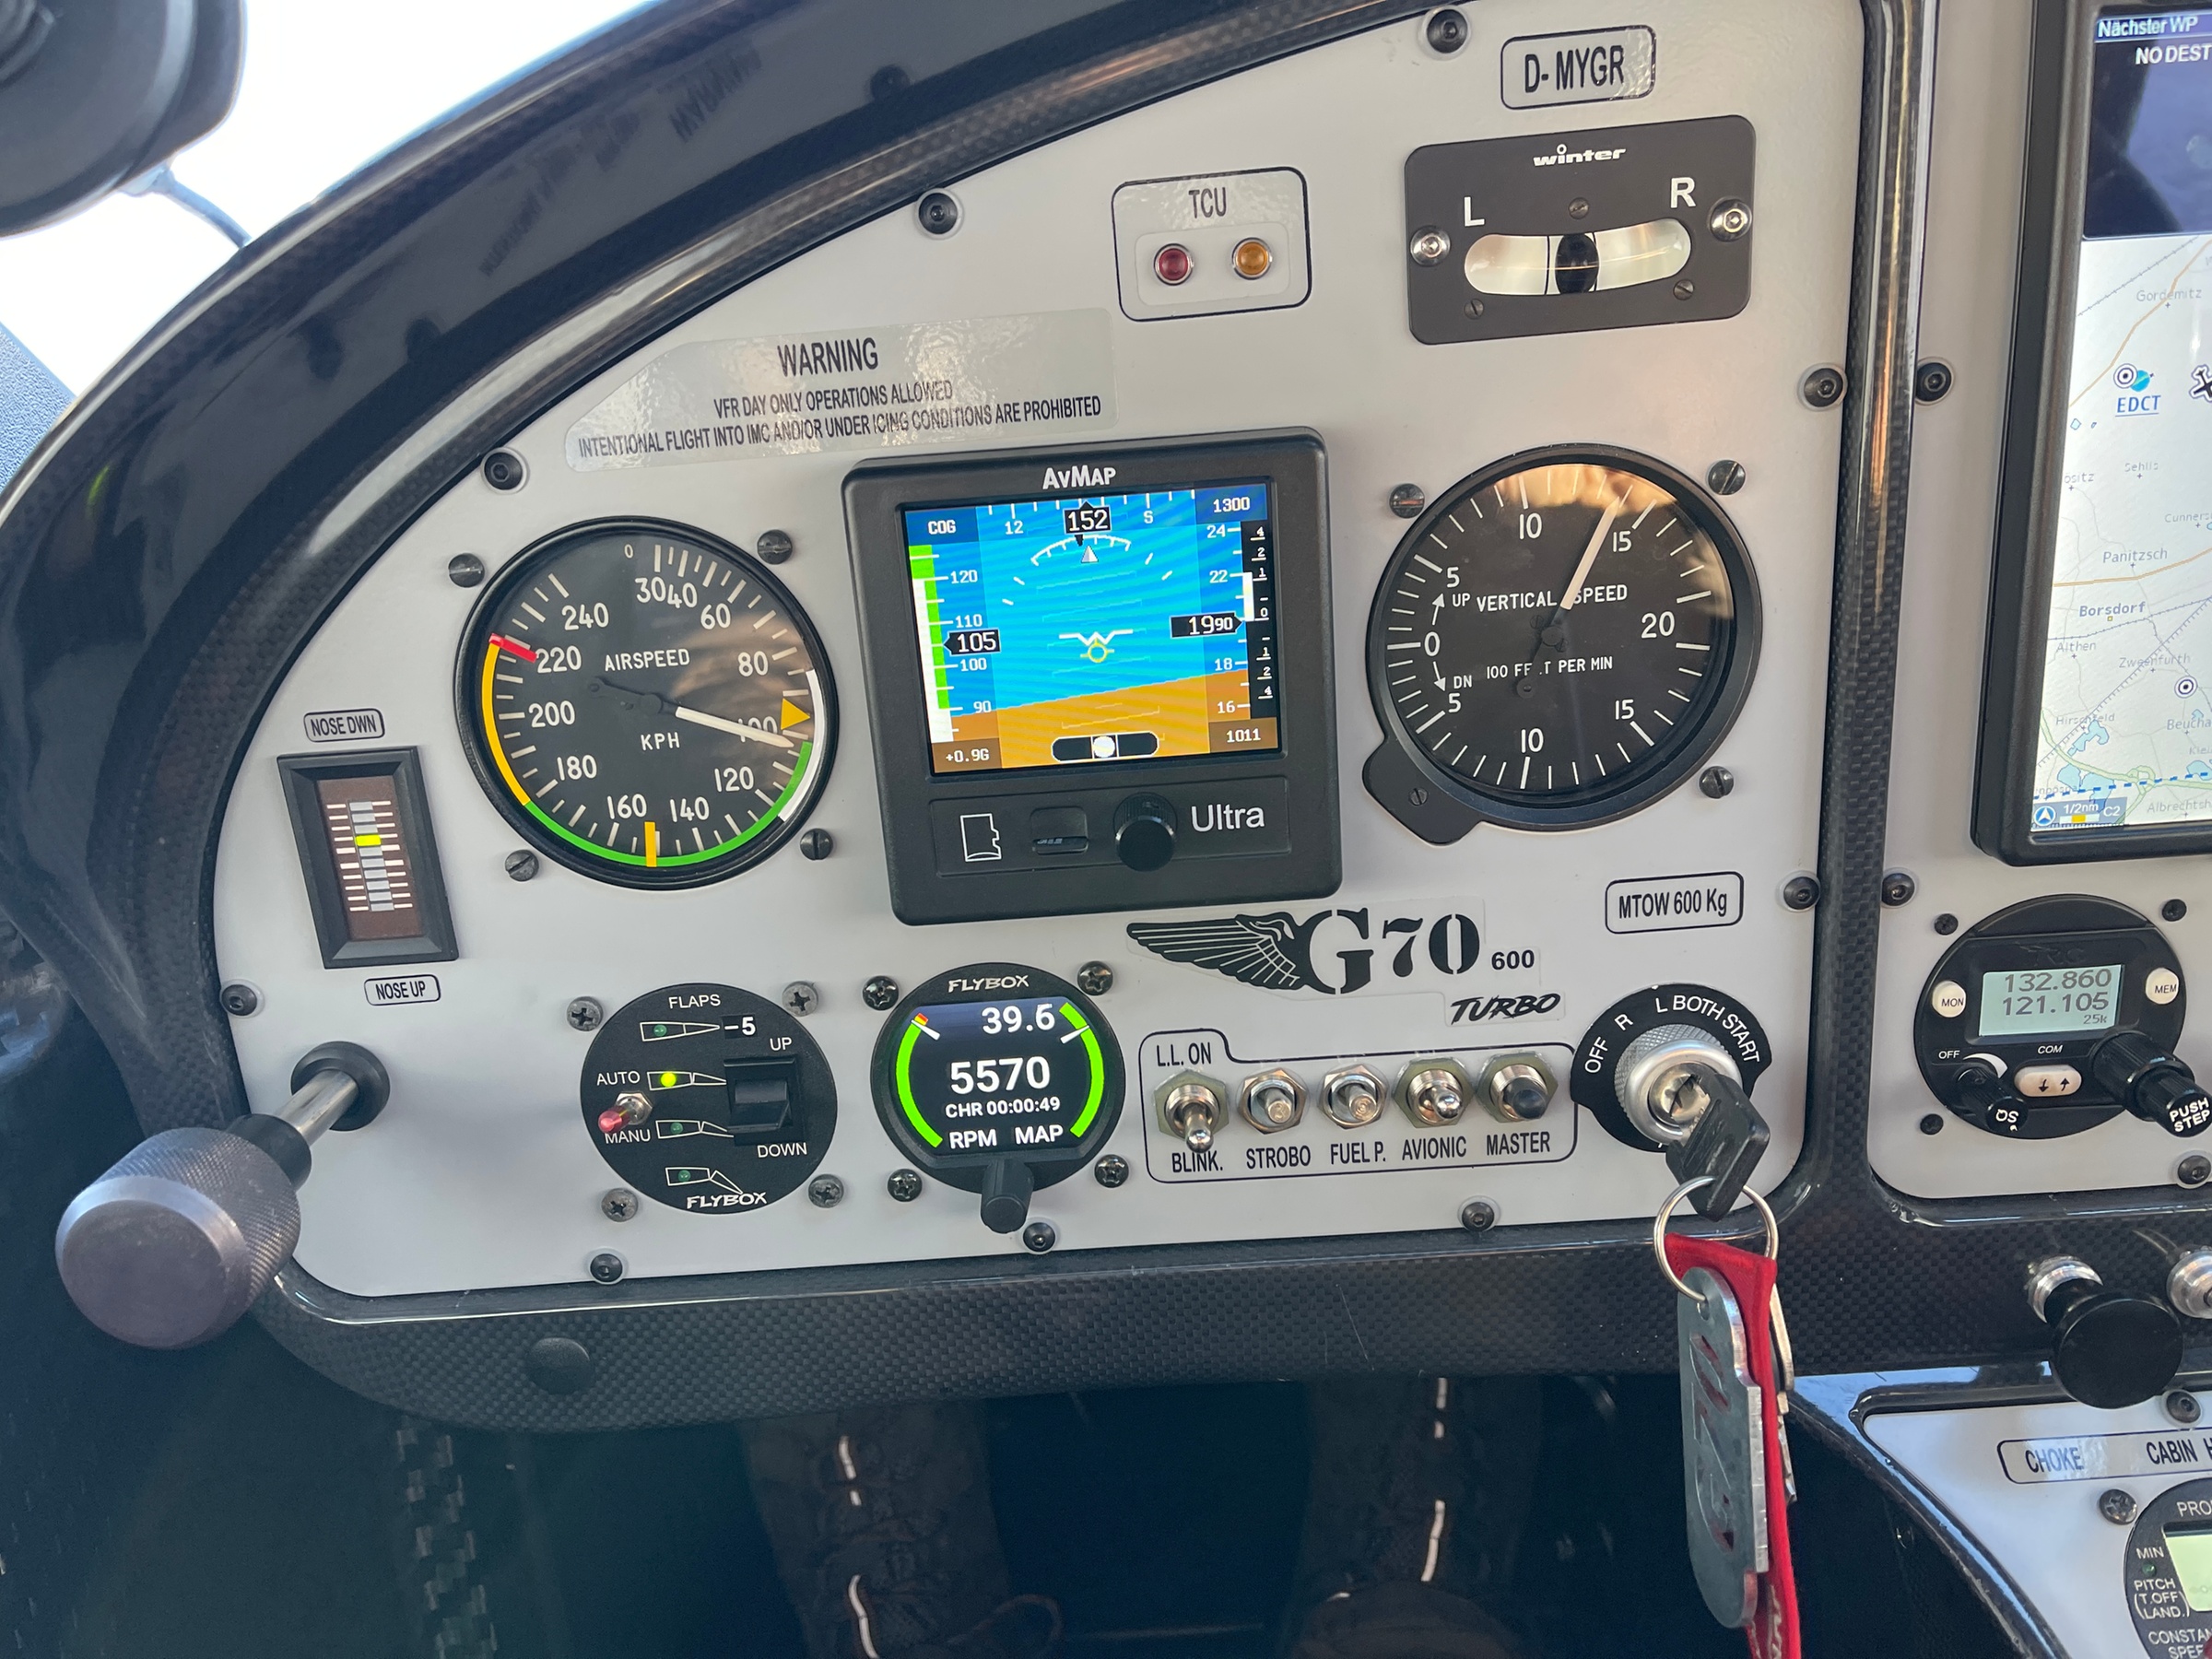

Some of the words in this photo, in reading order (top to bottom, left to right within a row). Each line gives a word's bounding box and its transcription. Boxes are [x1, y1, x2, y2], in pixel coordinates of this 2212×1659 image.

[2098, 18, 2168, 38] Nächster
[2170, 16, 2198, 32] WP
[2136, 46, 2163, 65] NO
[2165, 43, 2212, 63] DEST
[1556, 45, 1625, 91] MYGR
[1533, 143, 1627, 166] winter
[1188, 186, 1227, 219] TCU
[1669, 177, 1697, 209] R
[1463, 196, 1485, 228] L
[777, 337, 878, 377] WARNING
[713, 397, 741, 419] VFR
[742, 394, 767, 417] DAY
[770, 391, 803, 414] ONLY
[806, 385, 888, 411] OPERATIONS
[890, 380, 953, 404] ALLOWED
[2117, 395, 2161, 413] EDCT
[579, 431, 664, 458] INTENTIONAL
[665, 428, 710, 450] FLIGHT
[713, 425, 745, 447] INTO
[747, 423, 770, 444] IMC
[773, 418, 823, 441] AND/OR
[825, 414, 871, 438] UNDER
[873, 412, 910, 434] ICING
[912, 405, 993, 430] CONDITIONS
[995, 402, 1020, 424] ARE
[1023, 395, 1101, 422] PROHIBITED
[1213, 497, 1251, 513] 1300
[927, 519, 957, 535] COG
[1005, 521, 1024, 535] 12
[1067, 509, 1109, 532] 152
[1206, 524, 1227, 538] 24
[1256, 526, 1265, 536] 4
[1519, 513, 1543, 539] 10
[624, 545, 634, 559] 0
[1257, 547, 1265, 558] 2
[1612, 530, 1632, 553] 15
[2103, 547, 2168, 563] Panitzsch
[950, 569, 978, 583] 120
[1209, 570, 1228, 583] 22
[1259, 567, 1265, 578] 1
[1446, 567, 1460, 588] 5
[635, 576, 666, 603] 30
[667, 582, 698, 608] 40
[1452, 593, 1471, 607] UP
[1477, 590, 1558, 613] VERTICAL
[1571, 584, 1628, 605] SPEED
[562, 602, 610, 631] 240
[700, 605, 732, 629] 60
[1260, 607, 1268, 618] 0
[2079, 601, 2146, 618] Borsdorf
[955, 614, 982, 628] 110
[1188, 615, 1233, 636] 1990
[1641, 611, 1676, 639] 20
[957, 631, 996, 653] 105
[1263, 647, 1269, 657] 1
[1424, 631, 1441, 656] 0
[2056, 641, 2096, 653] Althen
[535, 645, 582, 675] 220
[605, 648, 690, 672] AIRSPEED
[737, 652, 769, 677] 80
[959, 657, 987, 671] 100
[1214, 658, 1233, 672] 18
[1487, 665, 1509, 679] 100
[1558, 658, 1586, 674] PER
[1590, 656, 1613, 671] MIN
[1264, 666, 1271, 677] 2
[1453, 675, 1473, 689] DN
[1264, 686, 1273, 696] 4
[528, 700, 576, 728] 200
[973, 700, 992, 713] 90
[1217, 700, 1236, 713] 16
[1449, 693, 1462, 713] 5
[1615, 699, 1635, 721] 15
[310, 717, 347, 738] NOSE
[347, 713, 377, 735] DWN
[1226, 727, 1262, 744] 1011
[2167, 718, 2211, 731] Beucha
[641, 732, 680, 751] KPH
[1520, 728, 1544, 753] 10
[557, 755, 597, 780] 180
[714, 767, 754, 792] 120
[606, 794, 647, 819] 160
[670, 797, 710, 822] 140
[1190, 803, 1265, 832] Ultra
[2063, 803, 2099, 815] 1/2nm
[2103, 806, 2120, 817] C2
[1618, 892, 1672, 919] MTOW
[1673, 891, 1702, 915] 600
[1705, 888, 1728, 917] Kg
[1309, 908, 1480, 994] G70
[1490, 948, 1535, 971] 600
[375, 982, 408, 1001] NOSE
[409, 980, 427, 997] UP
[947, 974, 1030, 993] FLYBOX
[2004, 969, 2112, 993] 132.860
[2154, 984, 2177, 994] MEM
[667, 993, 722, 1010] FLAPS
[1450, 993, 1562, 1026] TURBO
[1655, 997, 1668, 1013] L
[1673, 994, 1725, 1021] BOTH
[1941, 997, 1965, 1007] MON
[2002, 992, 2110, 1016] 121.105
[724, 1016, 757, 1036] -5
[982, 1003, 1055, 1034] 39.6
[1614, 1013, 1633, 1031] R
[2083, 1014, 2108, 1025] 25k
[769, 1036, 793, 1052] UP
[1722, 1014, 1760, 1063] START
[2037, 1044, 2064, 1054] COM
[1156, 1044, 1184, 1067] L.L.
[1188, 1042, 1212, 1065] ON
[1584, 1036, 1608, 1074] OFF
[1938, 1050, 1960, 1060] OFF
[596, 1070, 641, 1086] AUTO
[950, 1056, 1051, 1095] 5570
[945, 1102, 983, 1118] CHR
[986, 1096, 1061, 1115] 00:00:49
[2169, 1097, 2209, 1123] PUSH
[2174, 1109, 2211, 1133] STEP
[604, 1127, 652, 1143] MANU
[948, 1128, 997, 1149] RPM
[1015, 1124, 1064, 1144] MAP
[1486, 1131, 1550, 1156] MASTER
[757, 1142, 808, 1159] DOWN
[1246, 1145, 1312, 1170] STROBO
[1330, 1142, 1371, 1165] FUEL
[1373, 1141, 1386, 1162] P.
[1402, 1135, 1467, 1160] AVIONIC
[1171, 1150, 1223, 1173] BLINK.
[686, 1191, 768, 1209] FLYBOX
[2025, 1447, 2084, 1473] CHOKE
[2147, 1439, 2198, 1465] CABIN
[2176, 1500, 2212, 1518] PRO
[2136, 1547, 2165, 1559] MIN
[2134, 1578, 2176, 1591] PITCH
